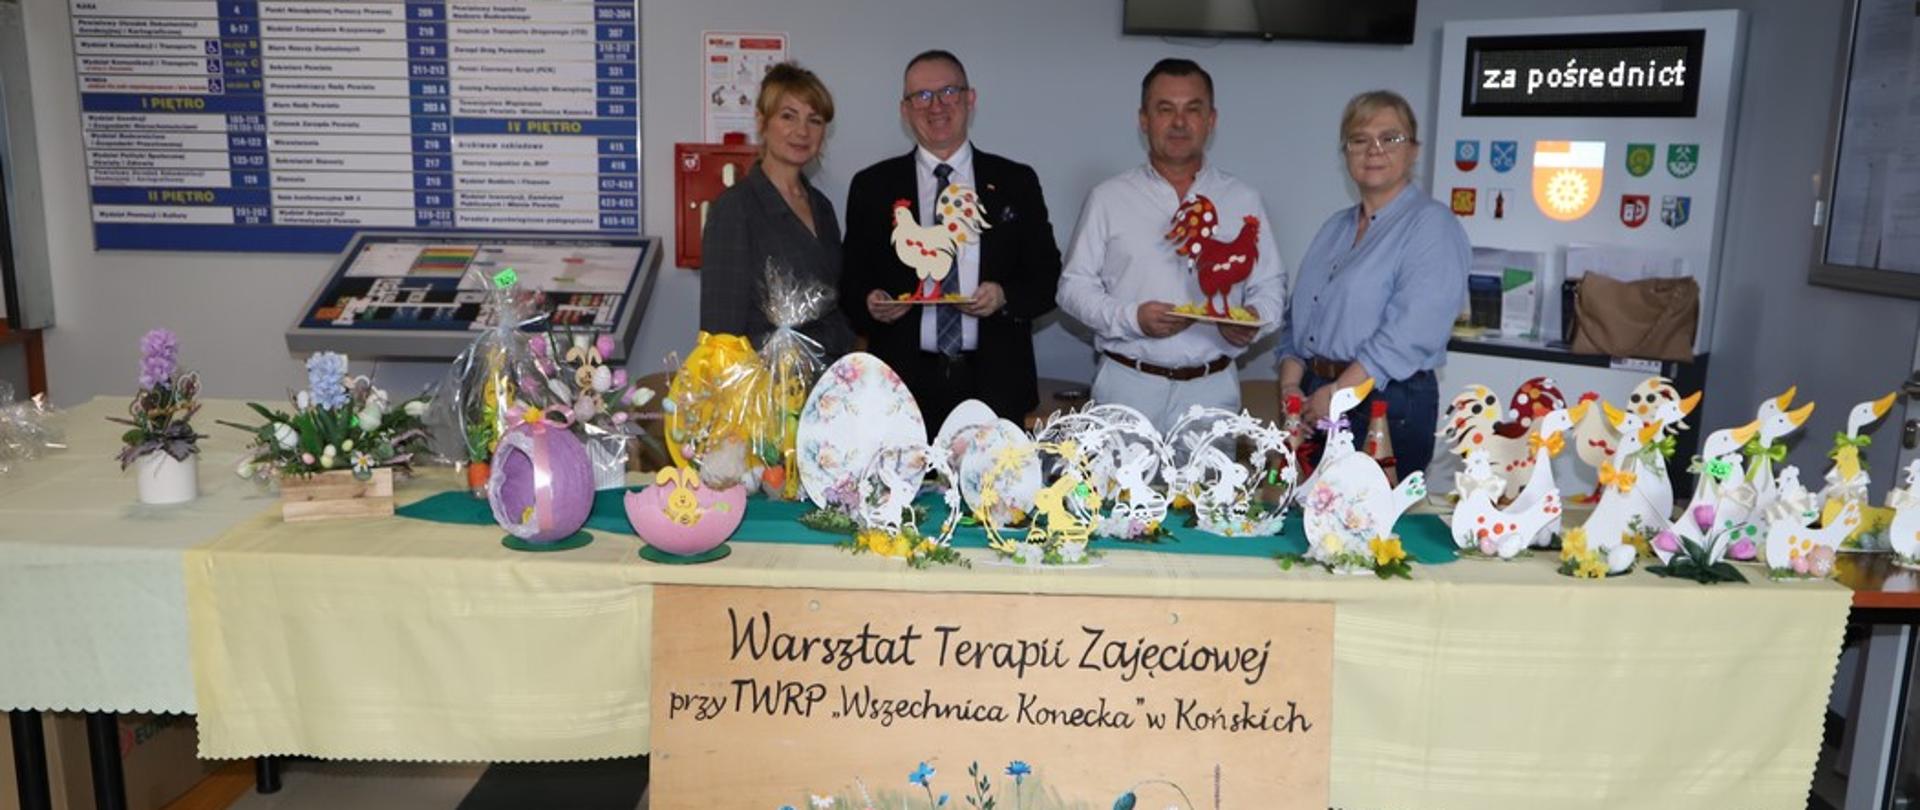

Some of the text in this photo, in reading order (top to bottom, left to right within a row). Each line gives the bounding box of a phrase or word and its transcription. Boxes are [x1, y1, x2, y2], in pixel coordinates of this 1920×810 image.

[1482, 58, 1686, 94] za pośrednict
[142, 98, 204, 111] I PIĘTRO
[508, 122, 581, 134] IV PIĘTRO
[148, 192, 214, 204] II PIĘTRO
[727, 607, 1272, 685] Warsztat Terapii Zajęciowej
[669, 691, 727, 721] przy
[731, 678, 827, 718] TWRP
[832, 684, 1008, 727] „Wszechnica
[1146, 711, 1166, 730] w
[1175, 698, 1312, 733] Końskich
